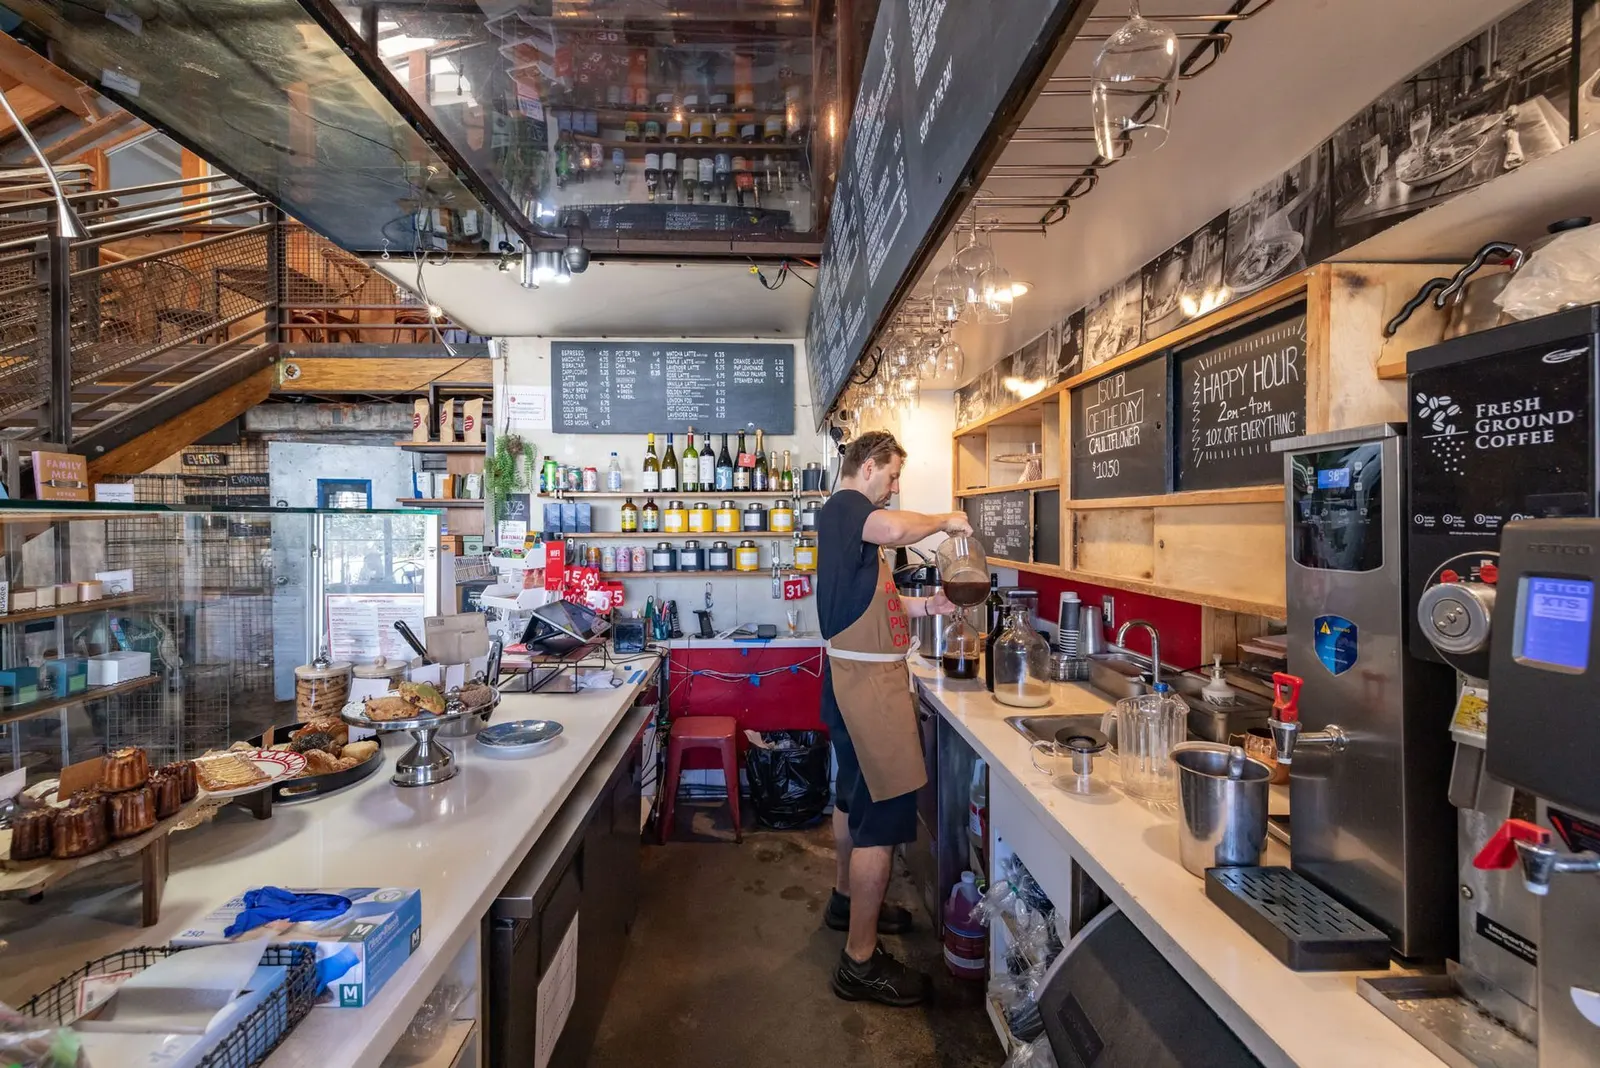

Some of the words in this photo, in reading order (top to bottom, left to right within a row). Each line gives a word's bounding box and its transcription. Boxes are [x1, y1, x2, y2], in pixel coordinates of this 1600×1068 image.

[1204, 363, 1248, 404] HAPPY
[1253, 346, 1298, 392] HOUR
[1100, 375, 1124, 403] SOUP
[1088, 412, 1099, 433] OF
[1101, 404, 1118, 430] THE
[1120, 397, 1141, 426] DAY
[1476, 397, 1540, 418] FRESH
[1205, 428, 1222, 446] 10%
[1224, 425, 1238, 443] OFF
[1241, 411, 1296, 440] EVERYTHING
[1475, 410, 1574, 434] GROUND
[1475, 430, 1554, 449] COFFEE
[46, 460, 82, 469] FAMILY
[187, 454, 220, 464] EVENTS
[52, 471, 79, 479] MEAL
[1528, 542, 1594, 555] FETCO
[786, 585, 800, 598] 31
[1534, 582, 1590, 594] FETCO
[350, 924, 372, 936] M
[411, 927, 420, 944] M
[343, 986, 357, 1000] M
